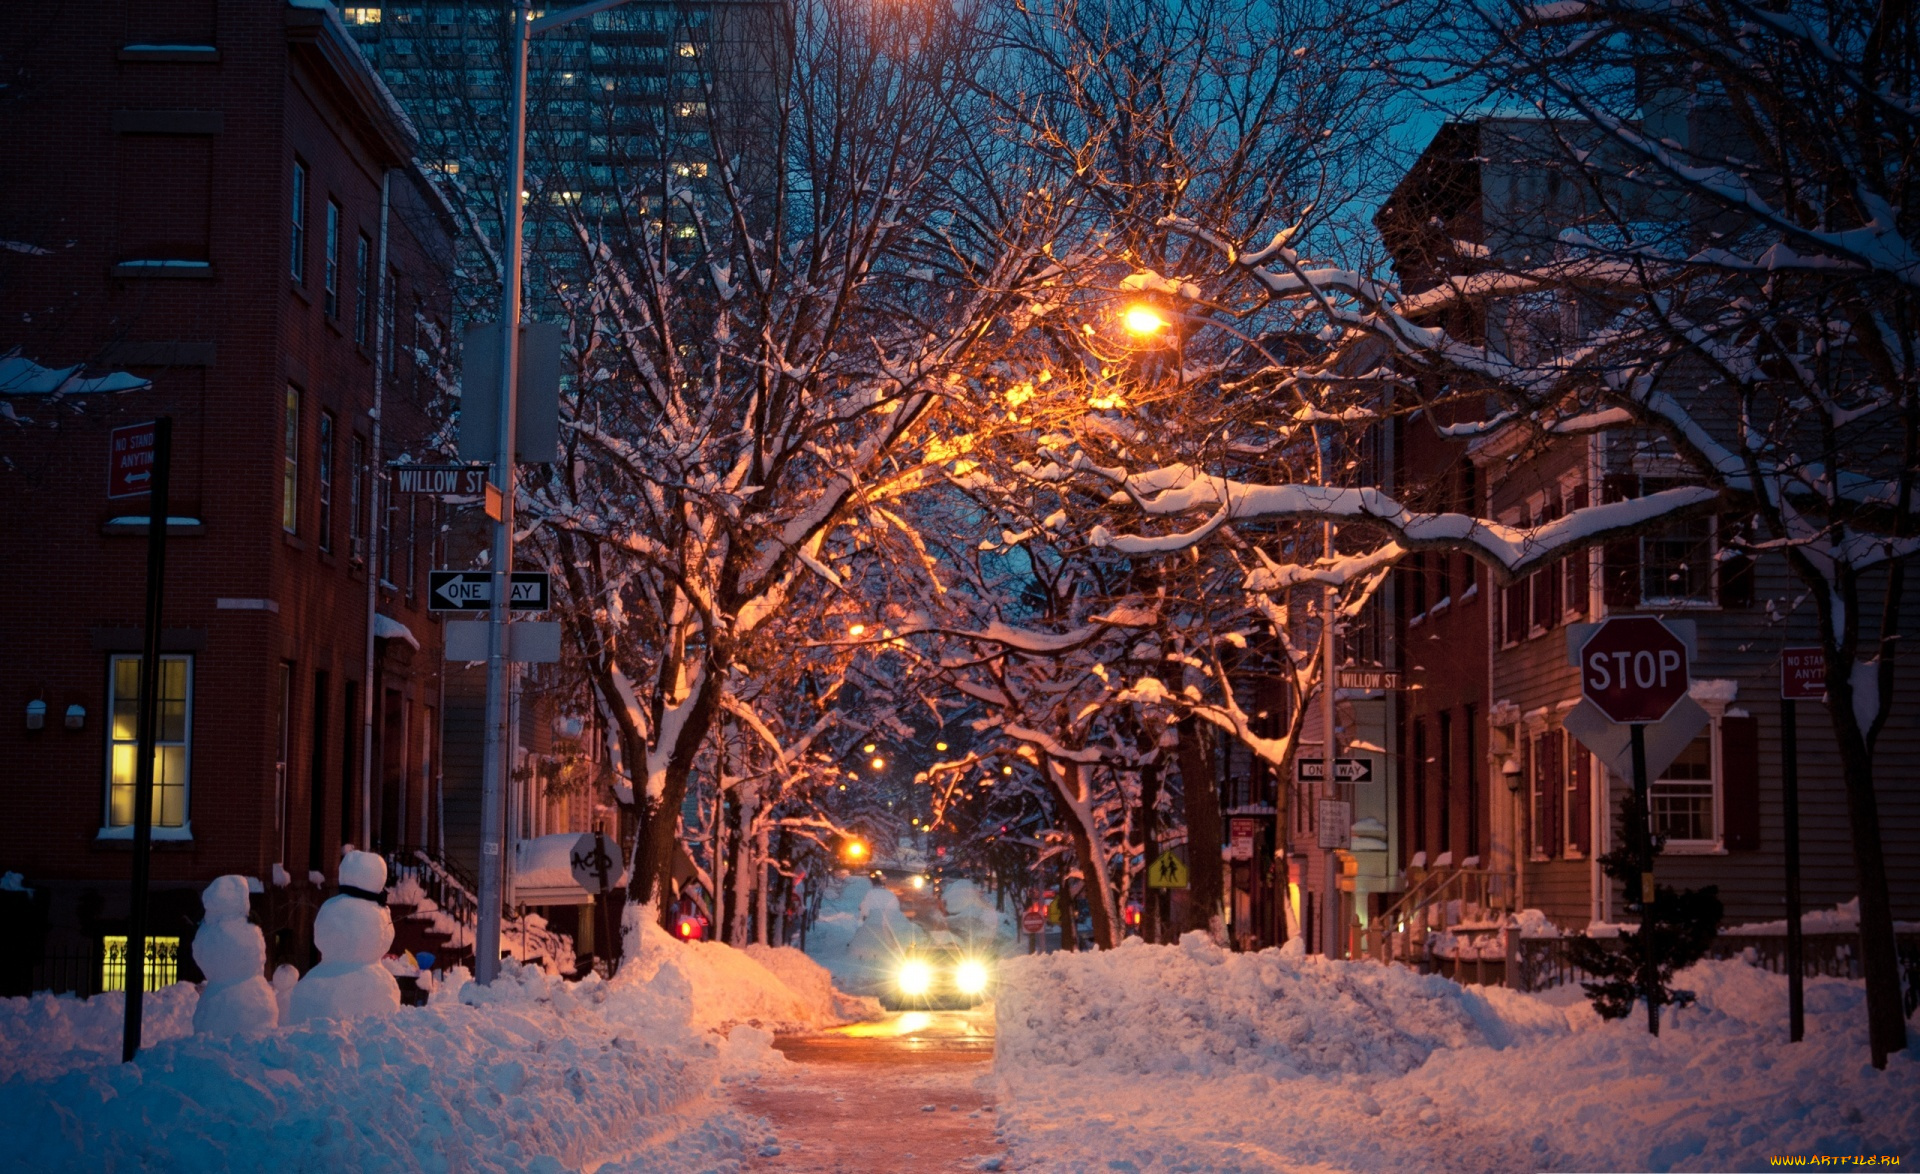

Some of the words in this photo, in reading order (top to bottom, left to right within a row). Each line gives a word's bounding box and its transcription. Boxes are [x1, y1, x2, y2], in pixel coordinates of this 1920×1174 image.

[116, 438, 127, 451] NO
[130, 433, 154, 449] STAND
[121, 450, 155, 468] ANYTIM
[400, 470, 458, 493] WILLOW
[466, 470, 484, 493] ST
[448, 584, 481, 599] ONE
[511, 584, 533, 599] AY
[1787, 656, 1800, 666] NO
[1589, 650, 1681, 691] STOP
[1341, 673, 1380, 688] WILLOW
[1384, 673, 1397, 688] ST
[1308, 765, 1323, 775] ON
[1340, 765, 1361, 776] WAY
